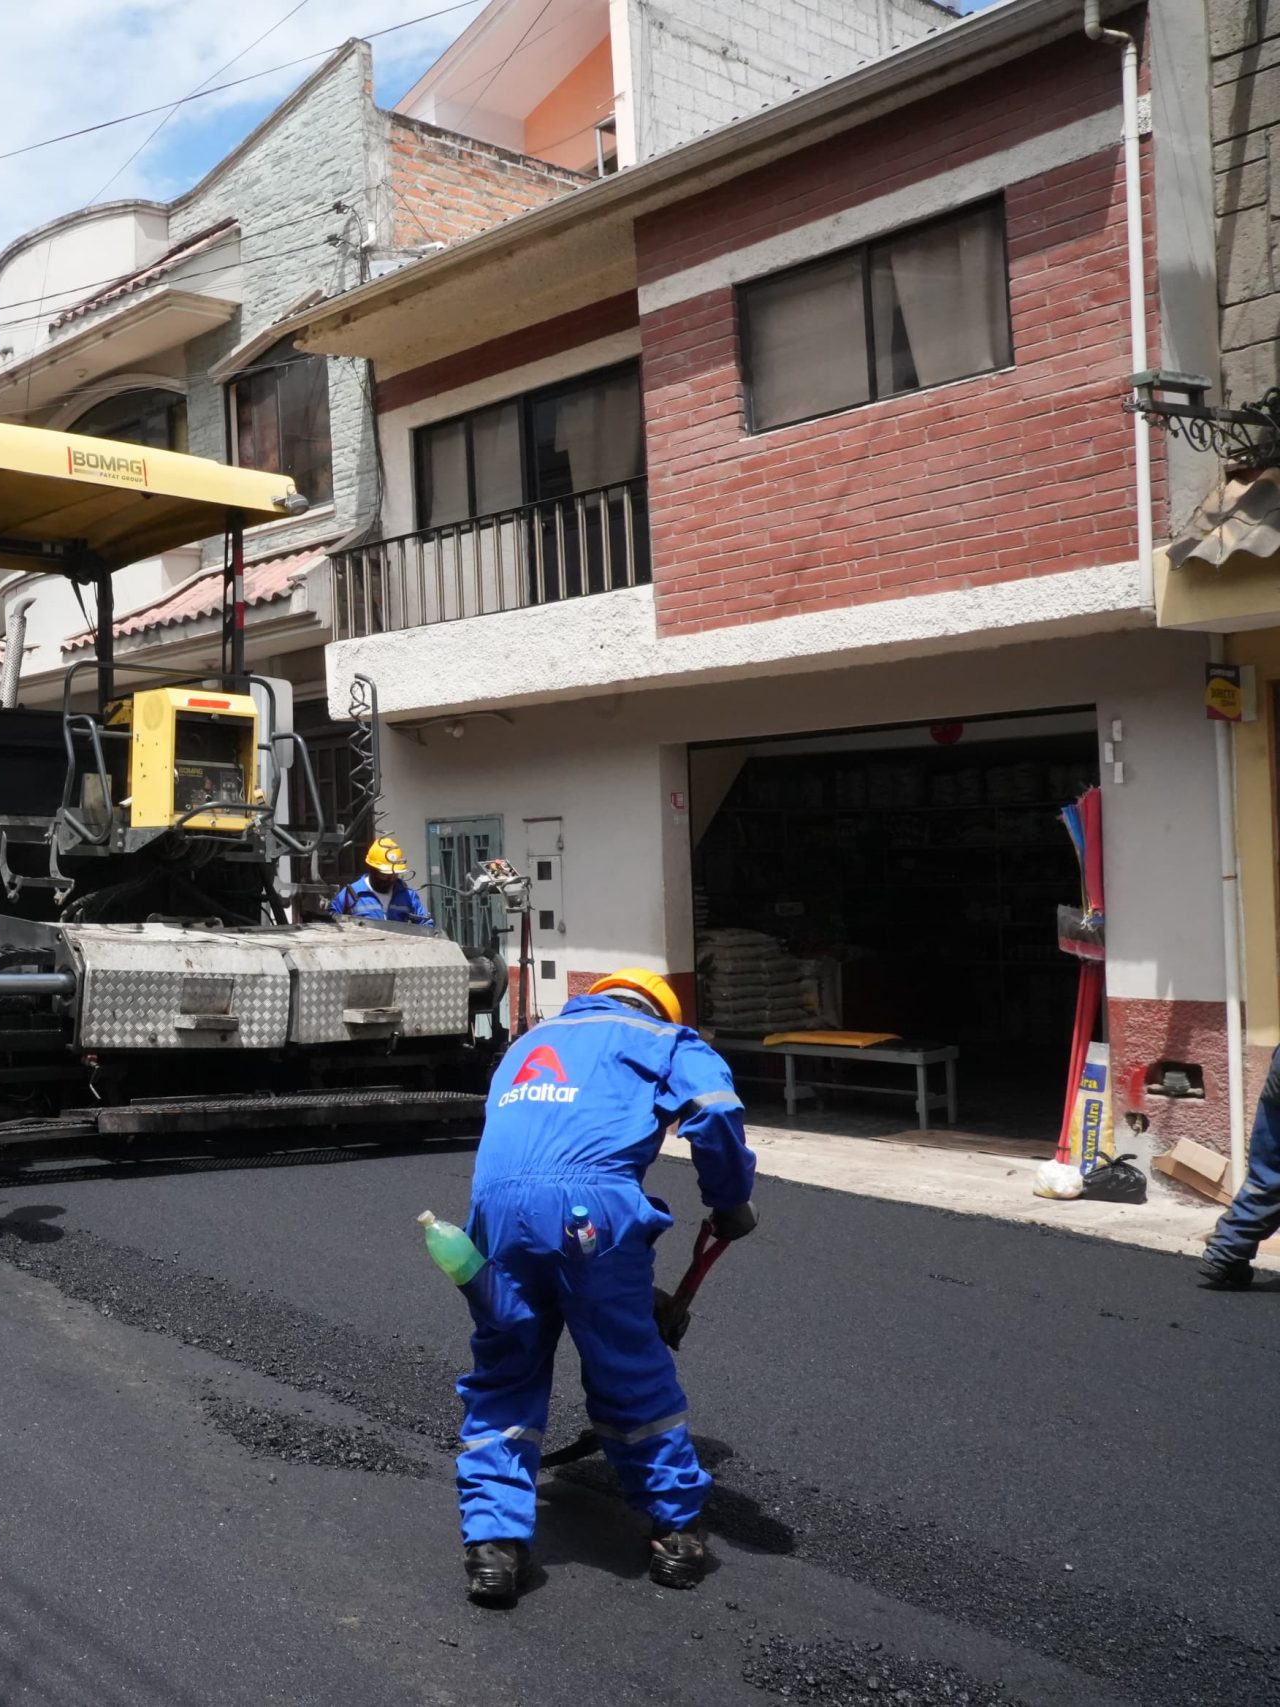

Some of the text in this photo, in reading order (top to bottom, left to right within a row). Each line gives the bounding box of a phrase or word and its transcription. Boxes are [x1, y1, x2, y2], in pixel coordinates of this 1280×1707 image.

[73, 450, 142, 475] BOMAG
[121, 475, 143, 483] GROUP
[498, 1083, 579, 1107] asfaltar
[1087, 1102, 1100, 1126] Lira
[1084, 1129, 1097, 1160] Extra
